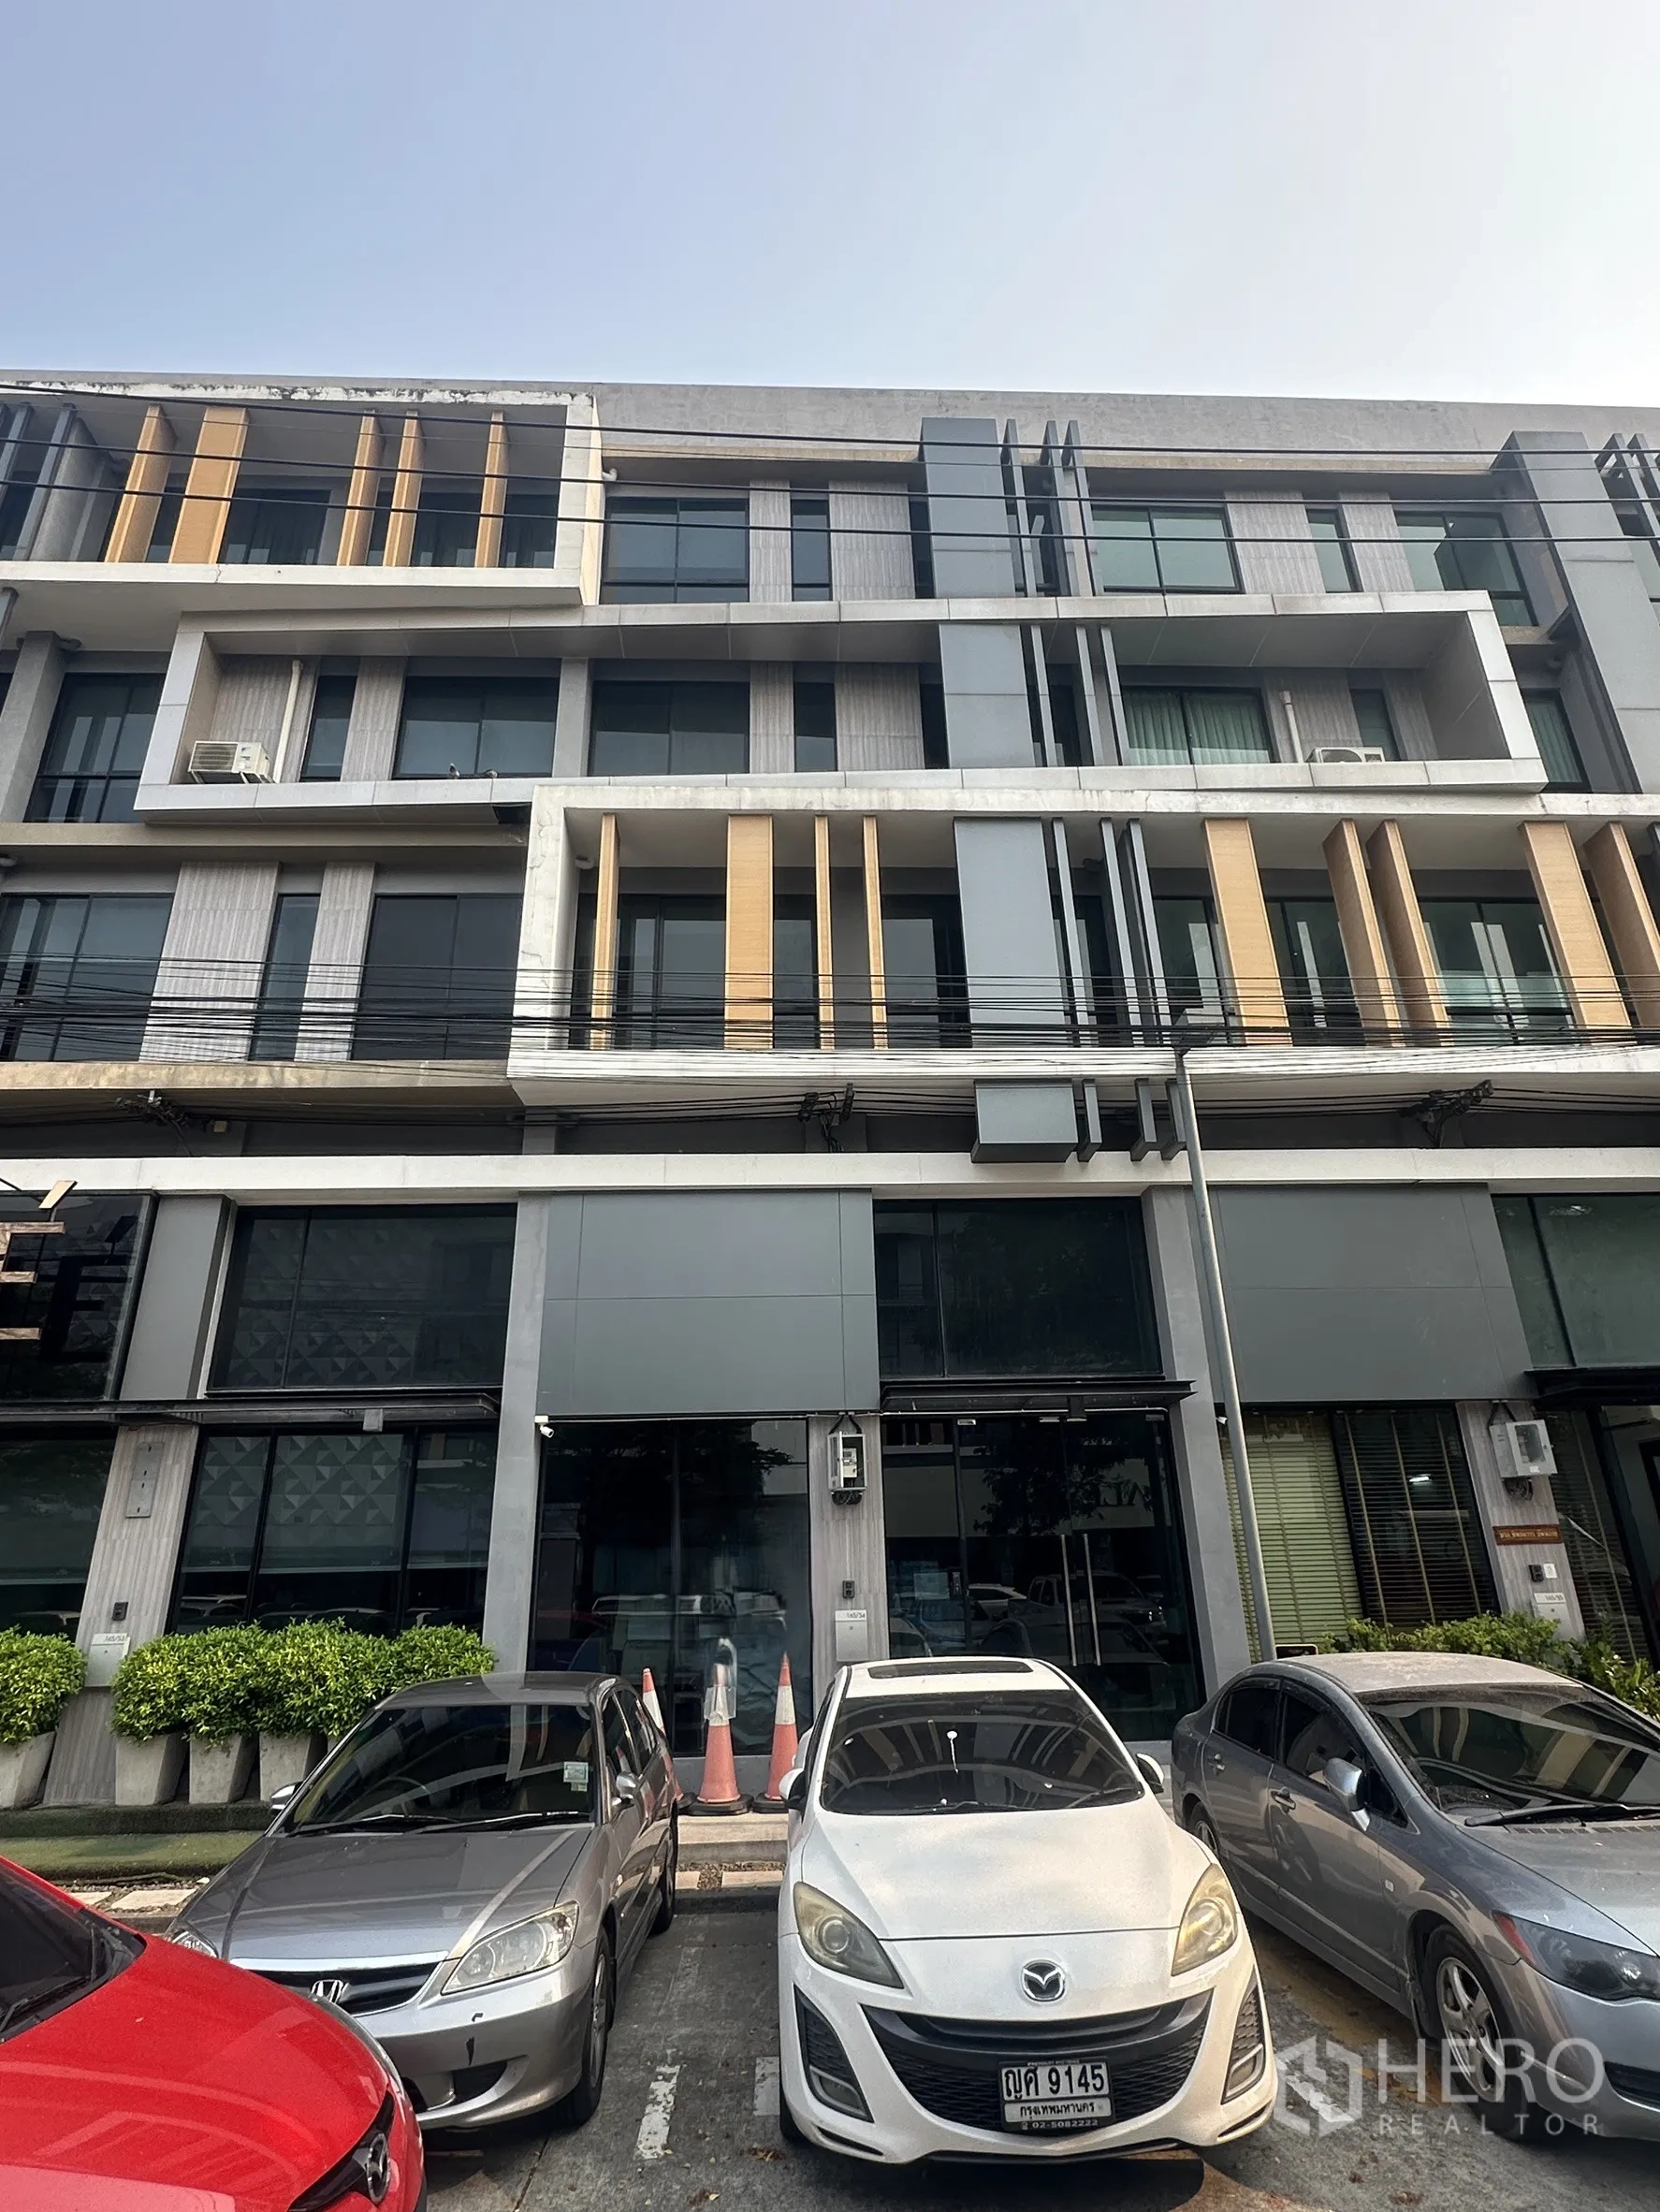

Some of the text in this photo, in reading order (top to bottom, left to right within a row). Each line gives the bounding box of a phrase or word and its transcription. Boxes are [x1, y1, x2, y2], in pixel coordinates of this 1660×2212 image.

[1004, 2064, 1104, 2100] ญศ 9145
[1020, 2102, 1095, 2120] กรุงเทพมหานคร
